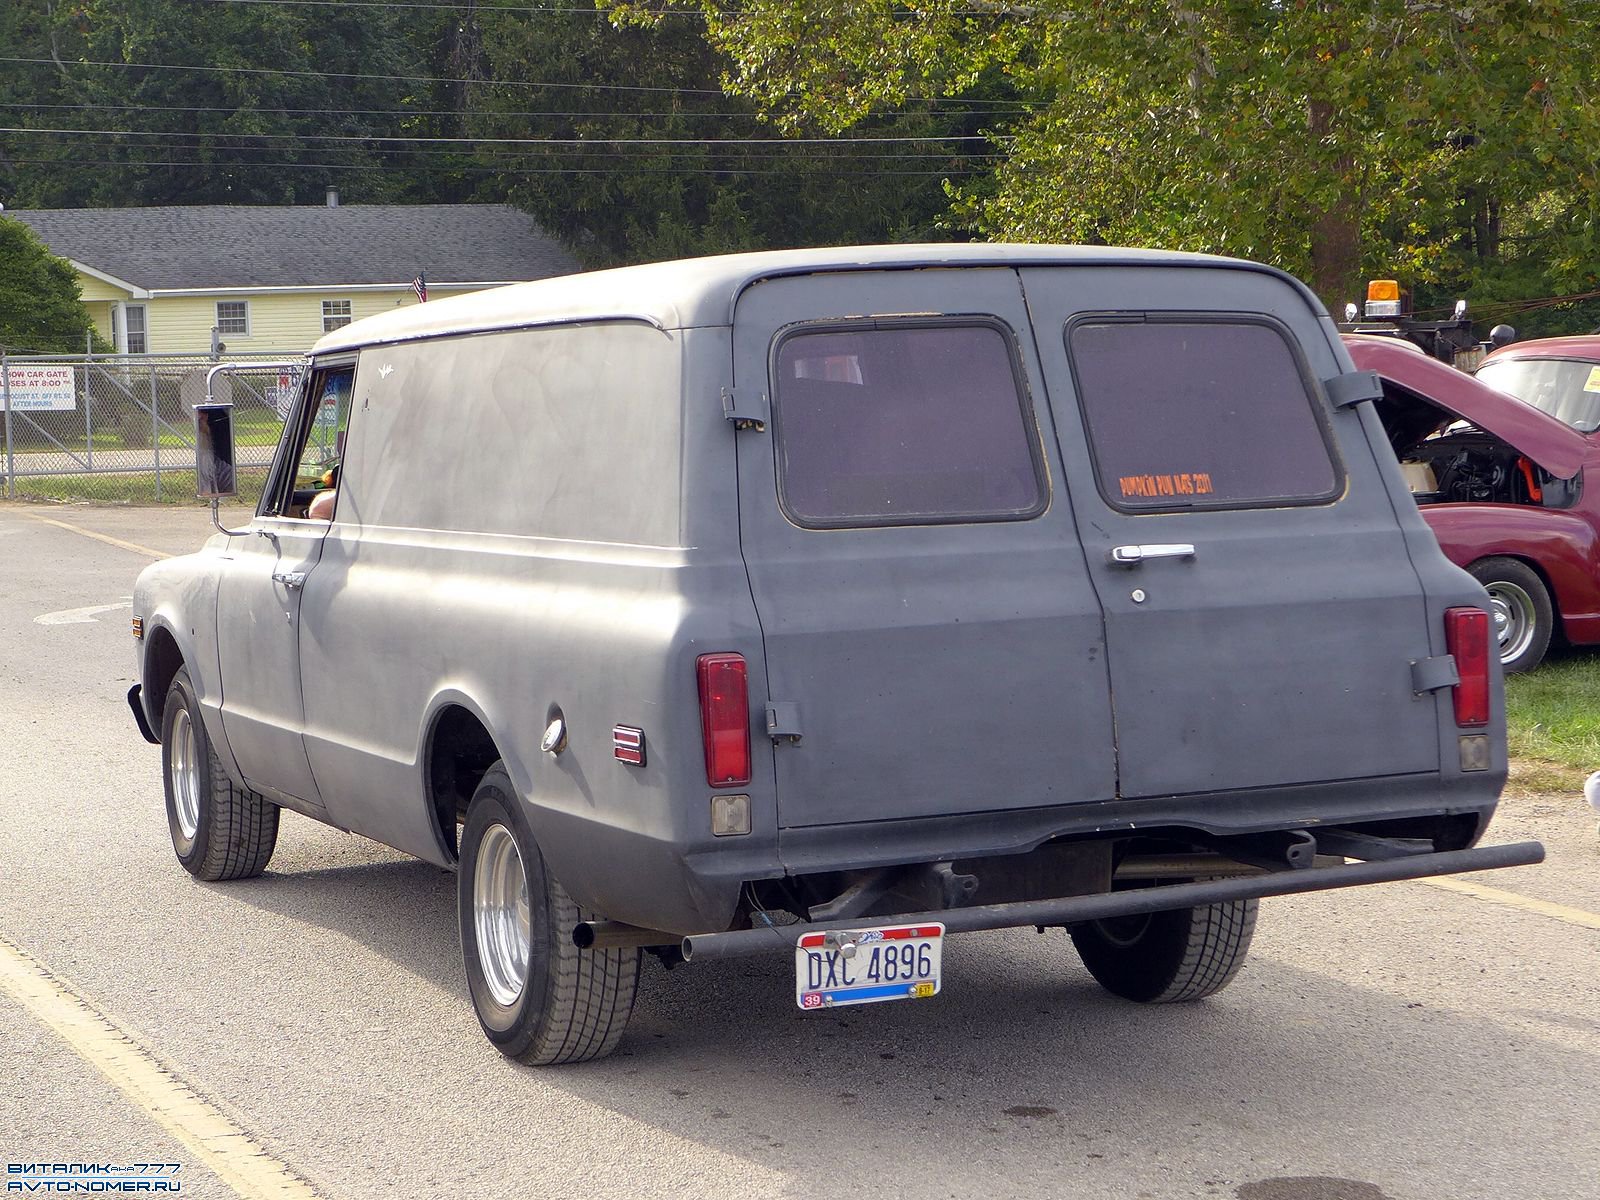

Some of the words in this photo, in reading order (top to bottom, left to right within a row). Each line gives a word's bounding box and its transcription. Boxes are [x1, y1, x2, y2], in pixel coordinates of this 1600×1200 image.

[1155, 474, 1175, 496] RUN
[809, 950, 856, 990] DXC
[867, 942, 932, 983] 4896
[804, 995, 821, 1006] 39
